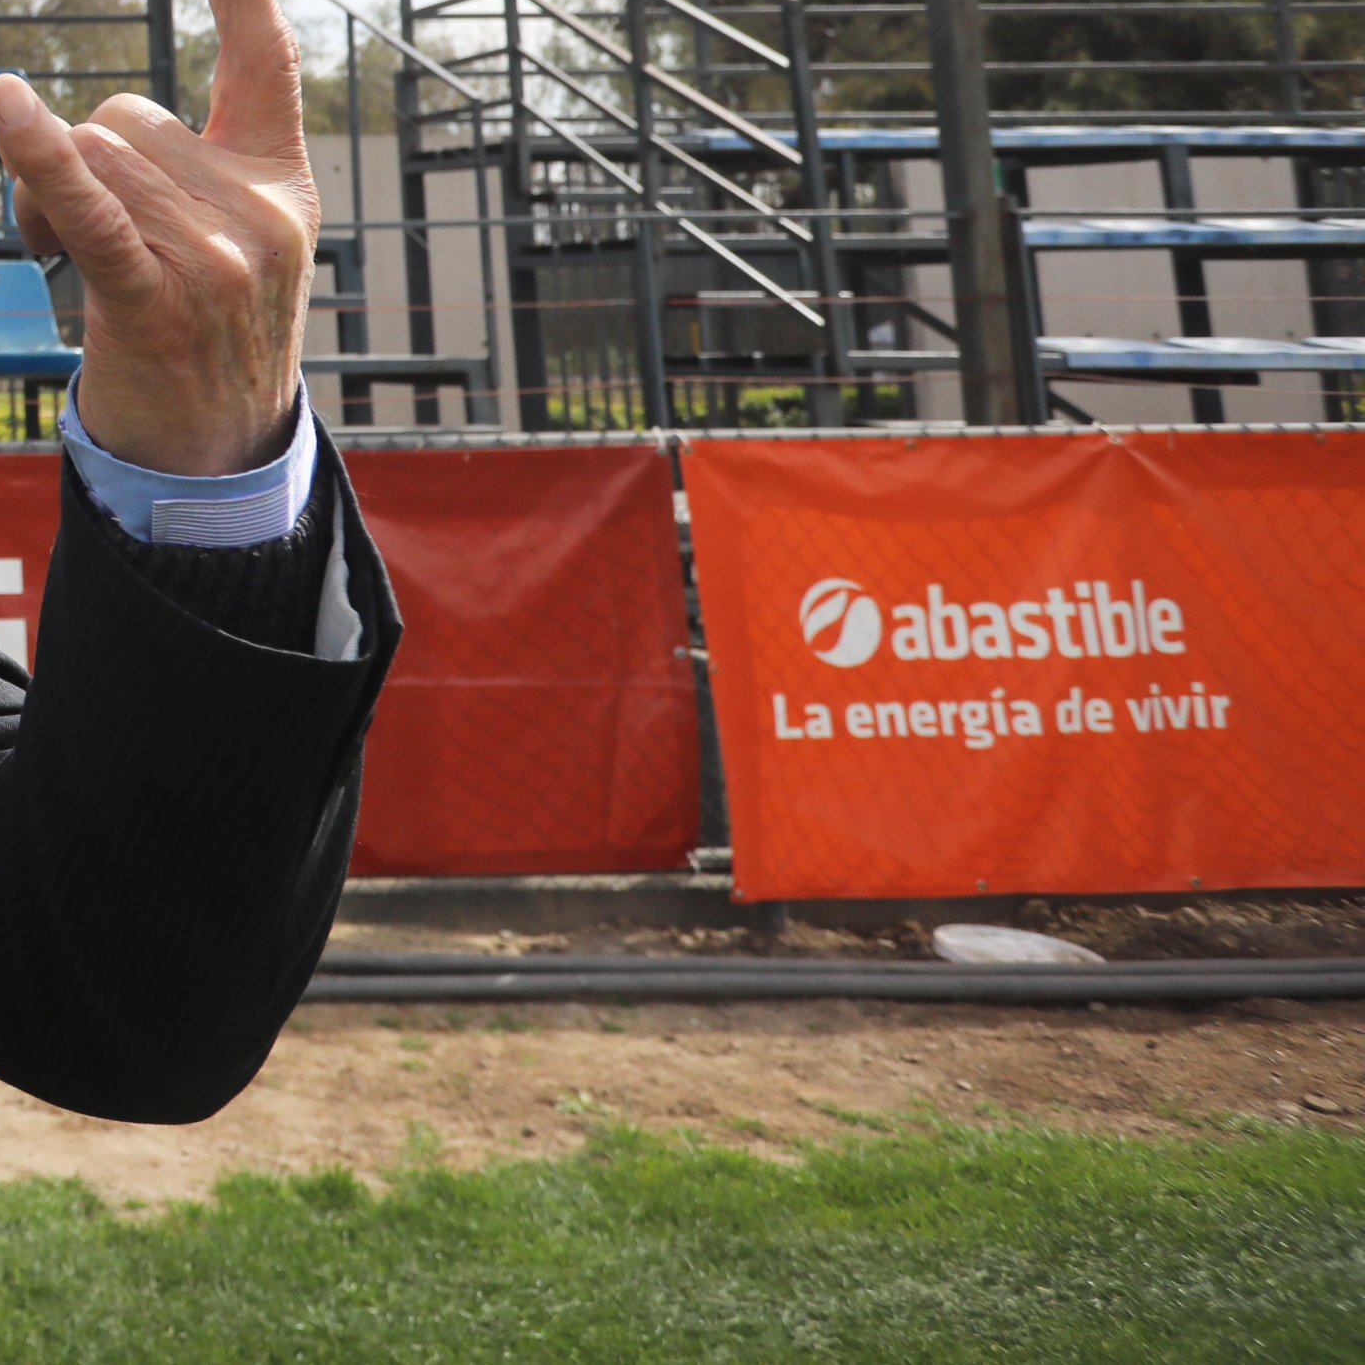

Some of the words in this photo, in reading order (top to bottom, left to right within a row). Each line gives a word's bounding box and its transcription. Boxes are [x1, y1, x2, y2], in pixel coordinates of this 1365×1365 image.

[890, 579, 1186, 660] abastible
[772, 692, 834, 739] La
[844, 687, 1042, 749] energía
[1055, 686, 1115, 733] de
[1125, 681, 1231, 732] vivir
